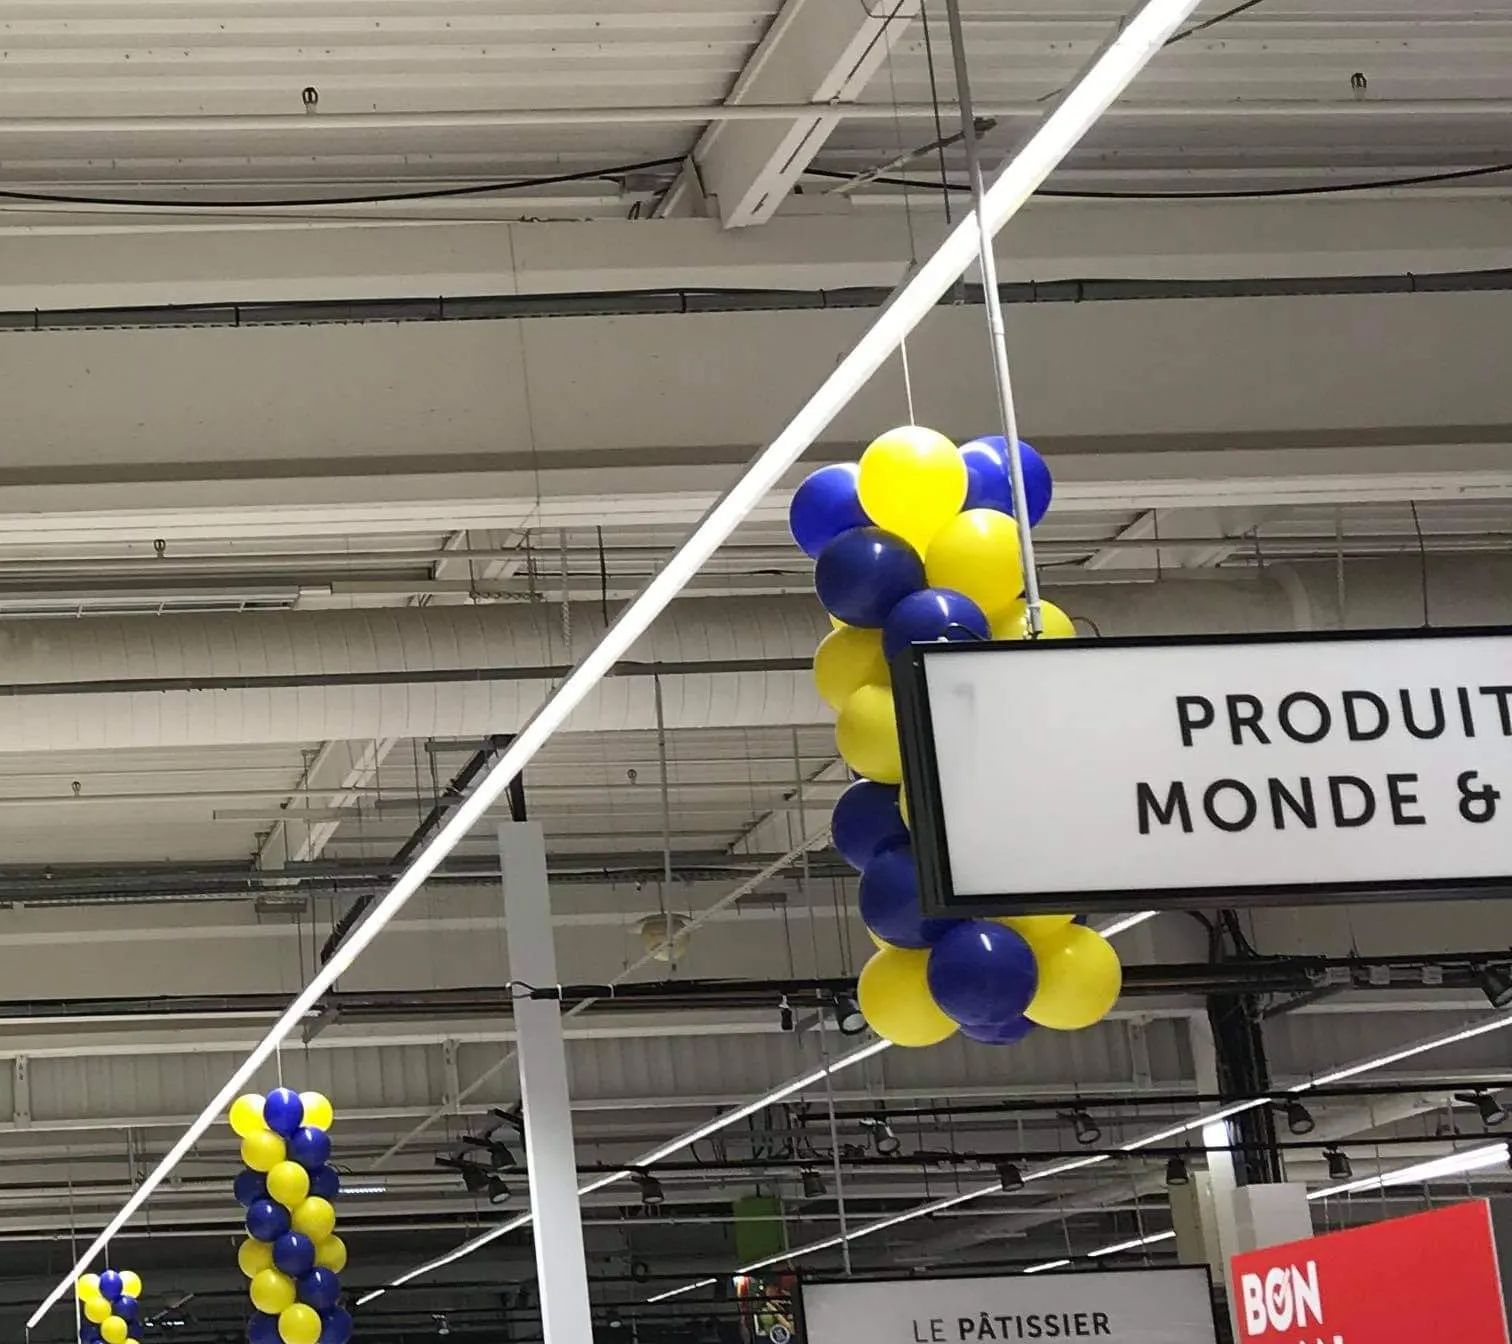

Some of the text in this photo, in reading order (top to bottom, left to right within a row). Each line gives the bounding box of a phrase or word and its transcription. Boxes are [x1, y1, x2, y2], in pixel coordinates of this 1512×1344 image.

[1135, 769, 1501, 834] MONDE &
[913, 1311, 1112, 1344] LE PÂTISSIER
[1241, 1260, 1324, 1336] BON
